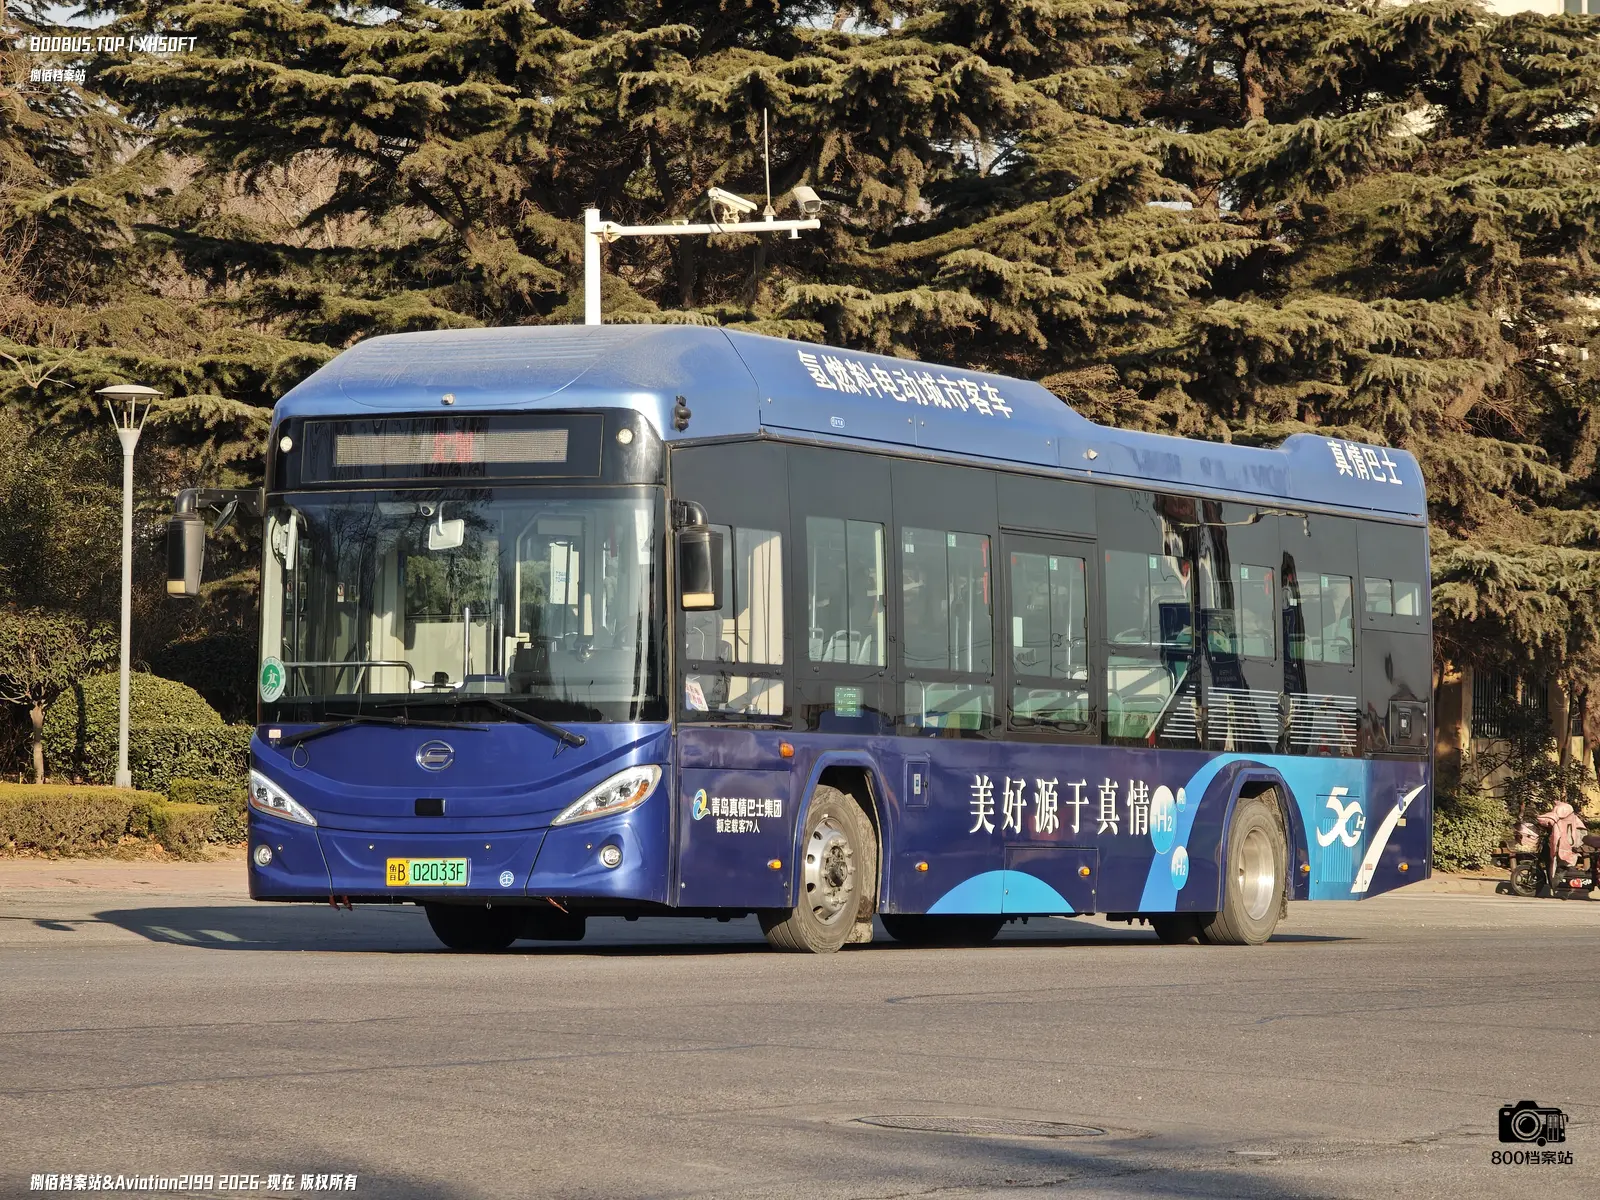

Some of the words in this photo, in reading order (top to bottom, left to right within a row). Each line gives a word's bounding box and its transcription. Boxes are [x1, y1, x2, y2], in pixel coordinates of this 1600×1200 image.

[798, 350, 1013, 418] 氢燃料电动城市客车
[1327, 440, 1403, 485] 真情巴士
[711, 797, 782, 818] 青岛真情巴士集团
[716, 818, 760, 833] 额定载客79人
[969, 774, 1150, 835] 美好源于真情
